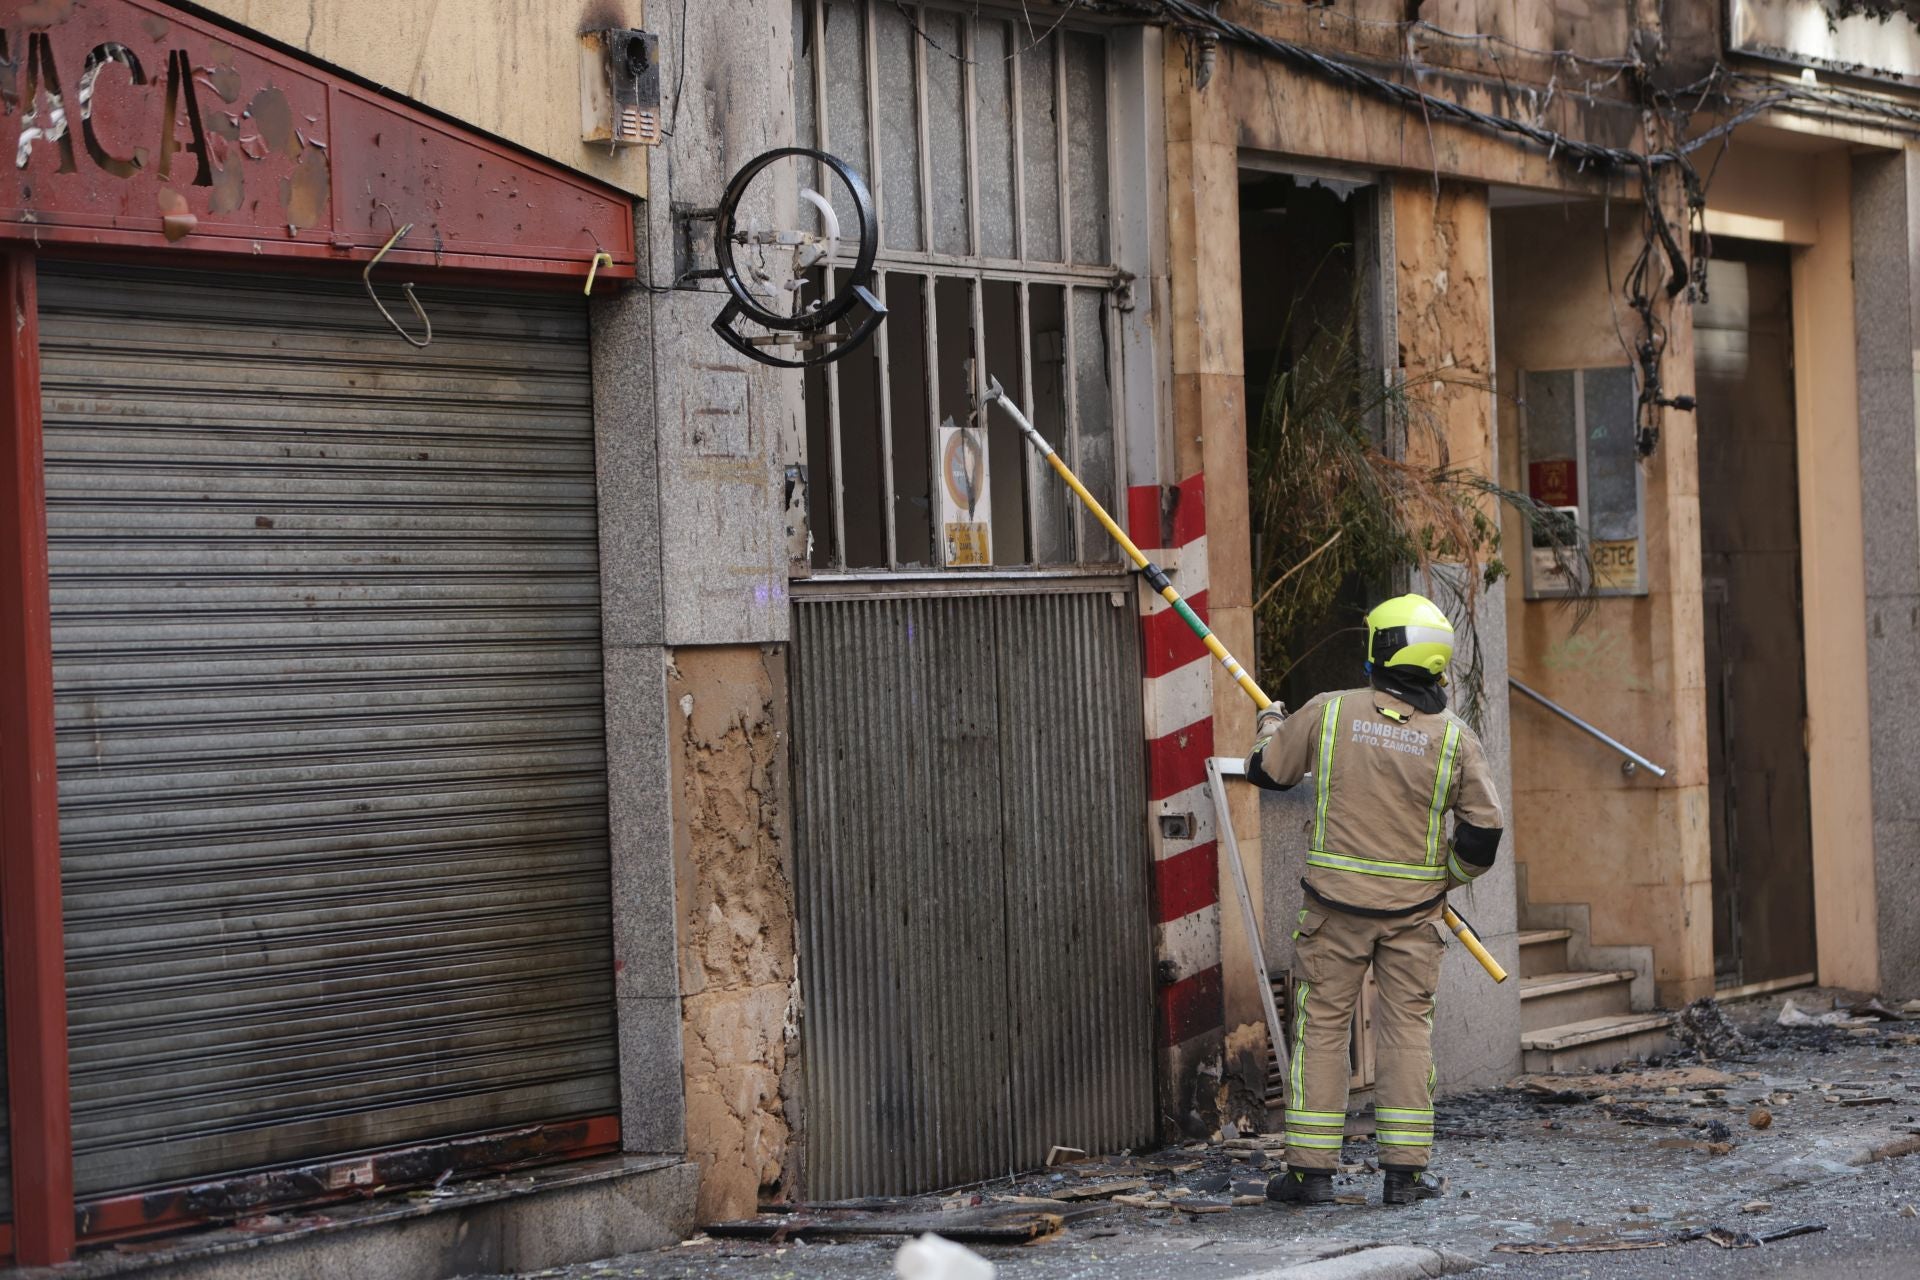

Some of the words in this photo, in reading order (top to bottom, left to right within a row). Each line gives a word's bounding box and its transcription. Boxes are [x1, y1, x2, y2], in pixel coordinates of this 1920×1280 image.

[0, 27, 213, 187] ACA
[1352, 720, 1428, 746] BOMBEROS
[1352, 734, 1379, 747] AYTO.
[1382, 739, 1425, 756] ZAMORA
